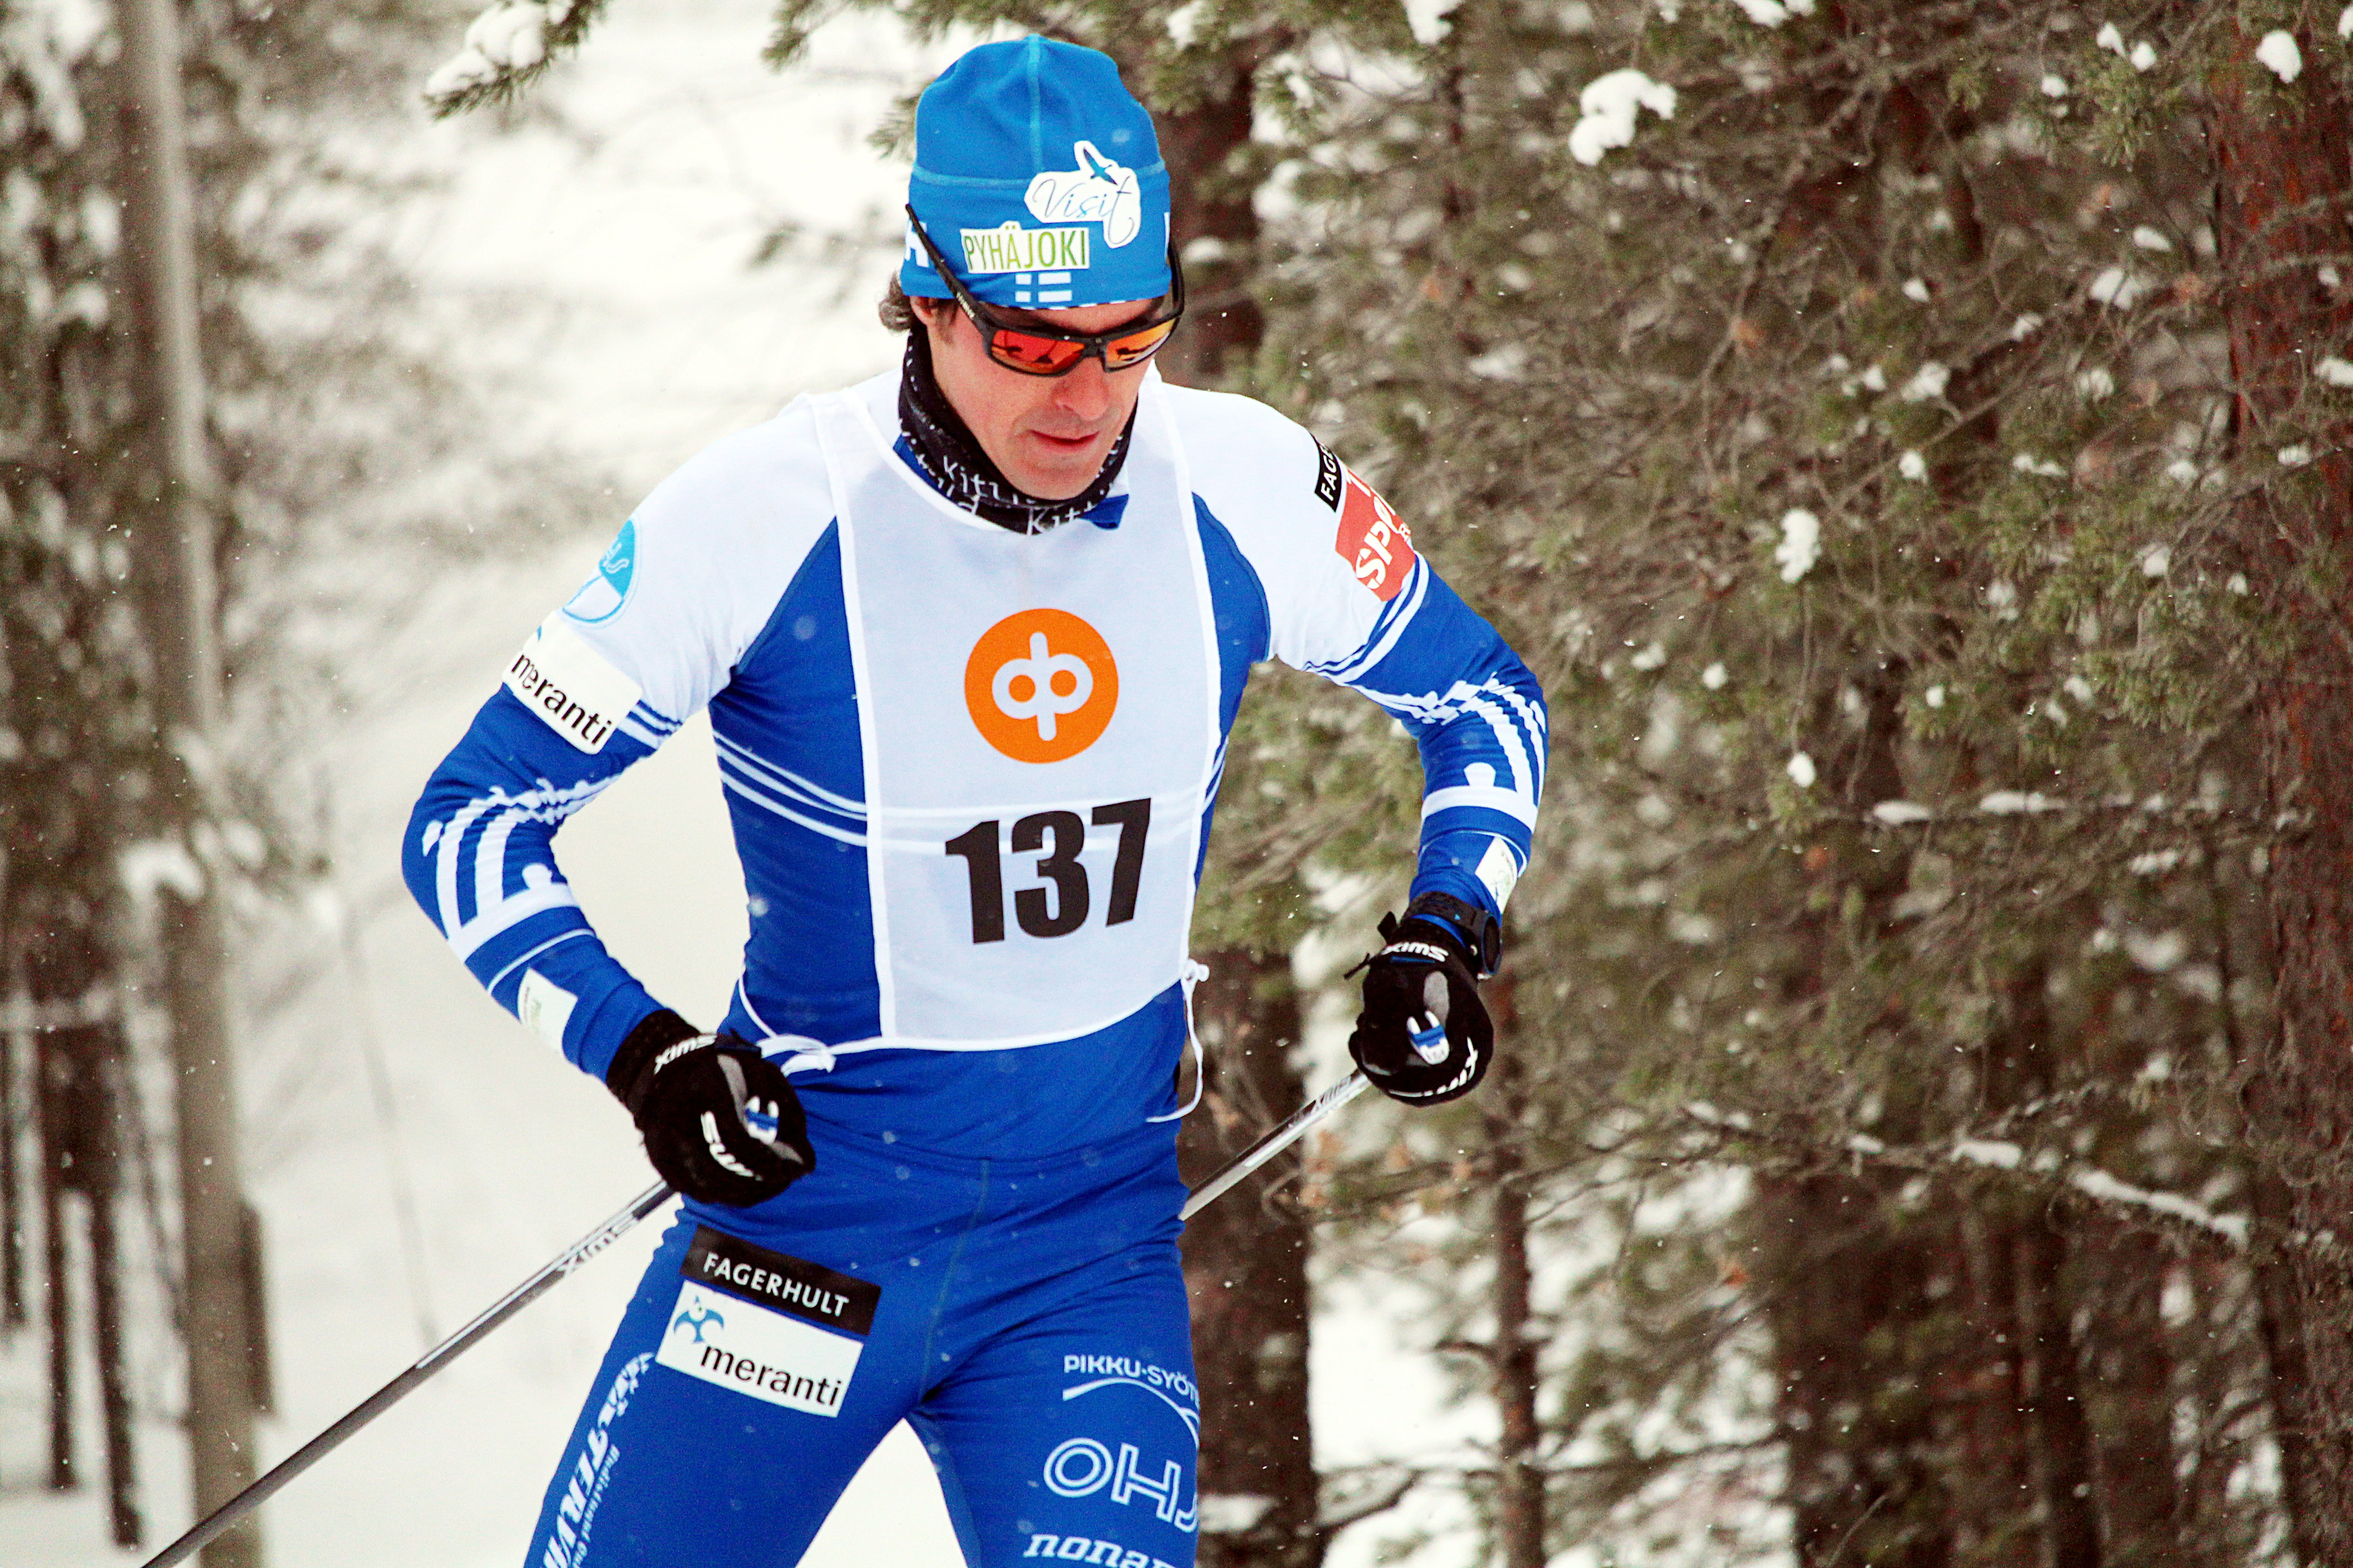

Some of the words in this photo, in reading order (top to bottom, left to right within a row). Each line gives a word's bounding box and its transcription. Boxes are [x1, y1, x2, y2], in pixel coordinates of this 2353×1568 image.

[1033, 175, 1136, 245] Visit
[964, 225, 1087, 270] PYHÄJOKI
[510, 654, 612, 745] meranti
[946, 797, 1151, 944] 137
[703, 1252, 849, 1317] FAGERHULT
[700, 1346, 841, 1406] meranti
